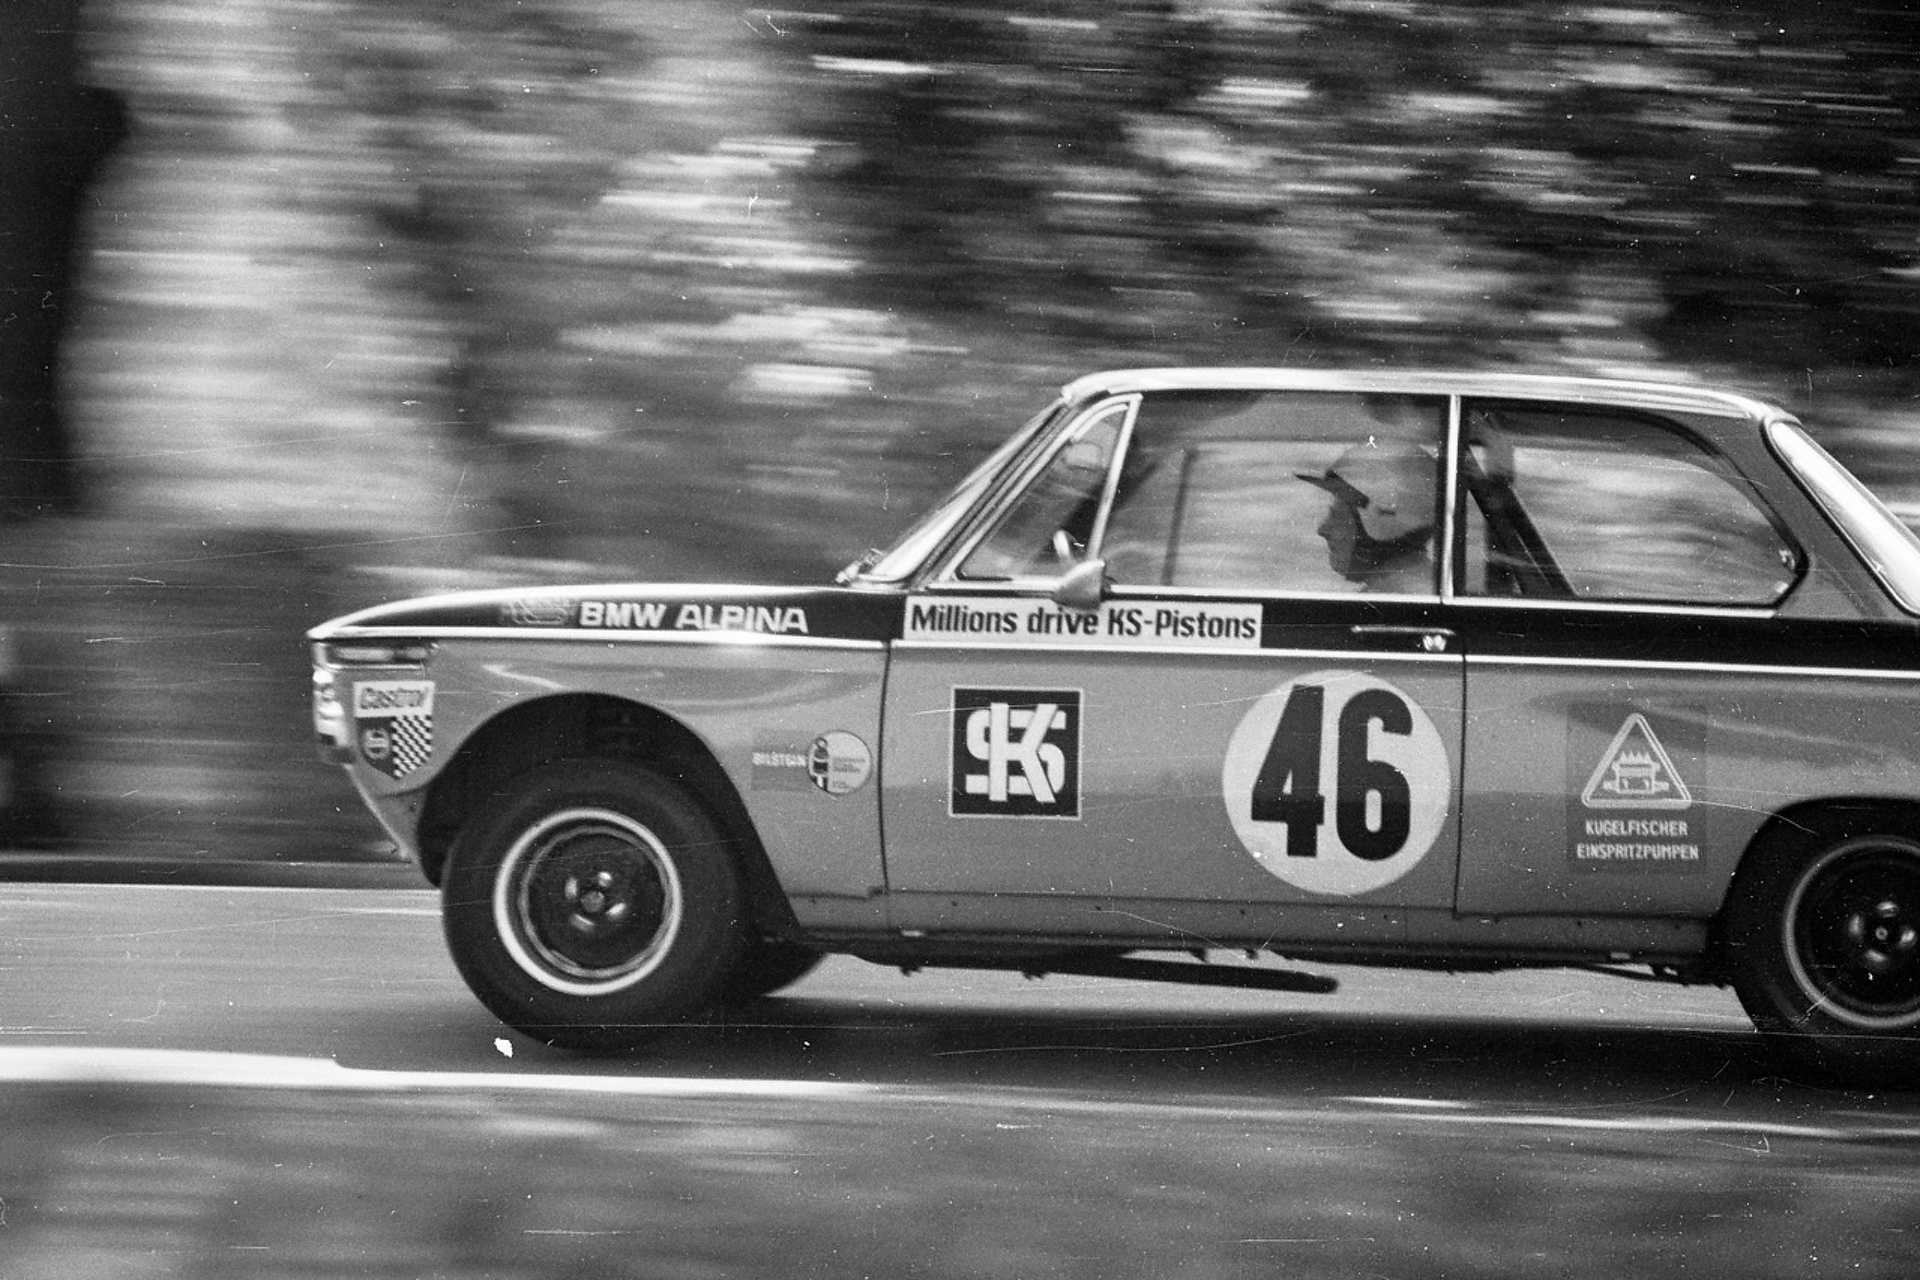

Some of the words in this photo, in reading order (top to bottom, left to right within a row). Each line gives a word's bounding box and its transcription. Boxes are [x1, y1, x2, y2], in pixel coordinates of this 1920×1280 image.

[578, 601, 667, 628] BMW
[675, 604, 809, 633] ALPINA
[911, 604, 1018, 633] Millions
[1027, 606, 1099, 635] drive
[1107, 608, 1257, 639] KS-Pistons
[1251, 684, 1414, 862] 46
[1585, 819, 1689, 837] KUGELFISCHER
[1576, 843, 1700, 860] EINSPRITZPUMPEN
